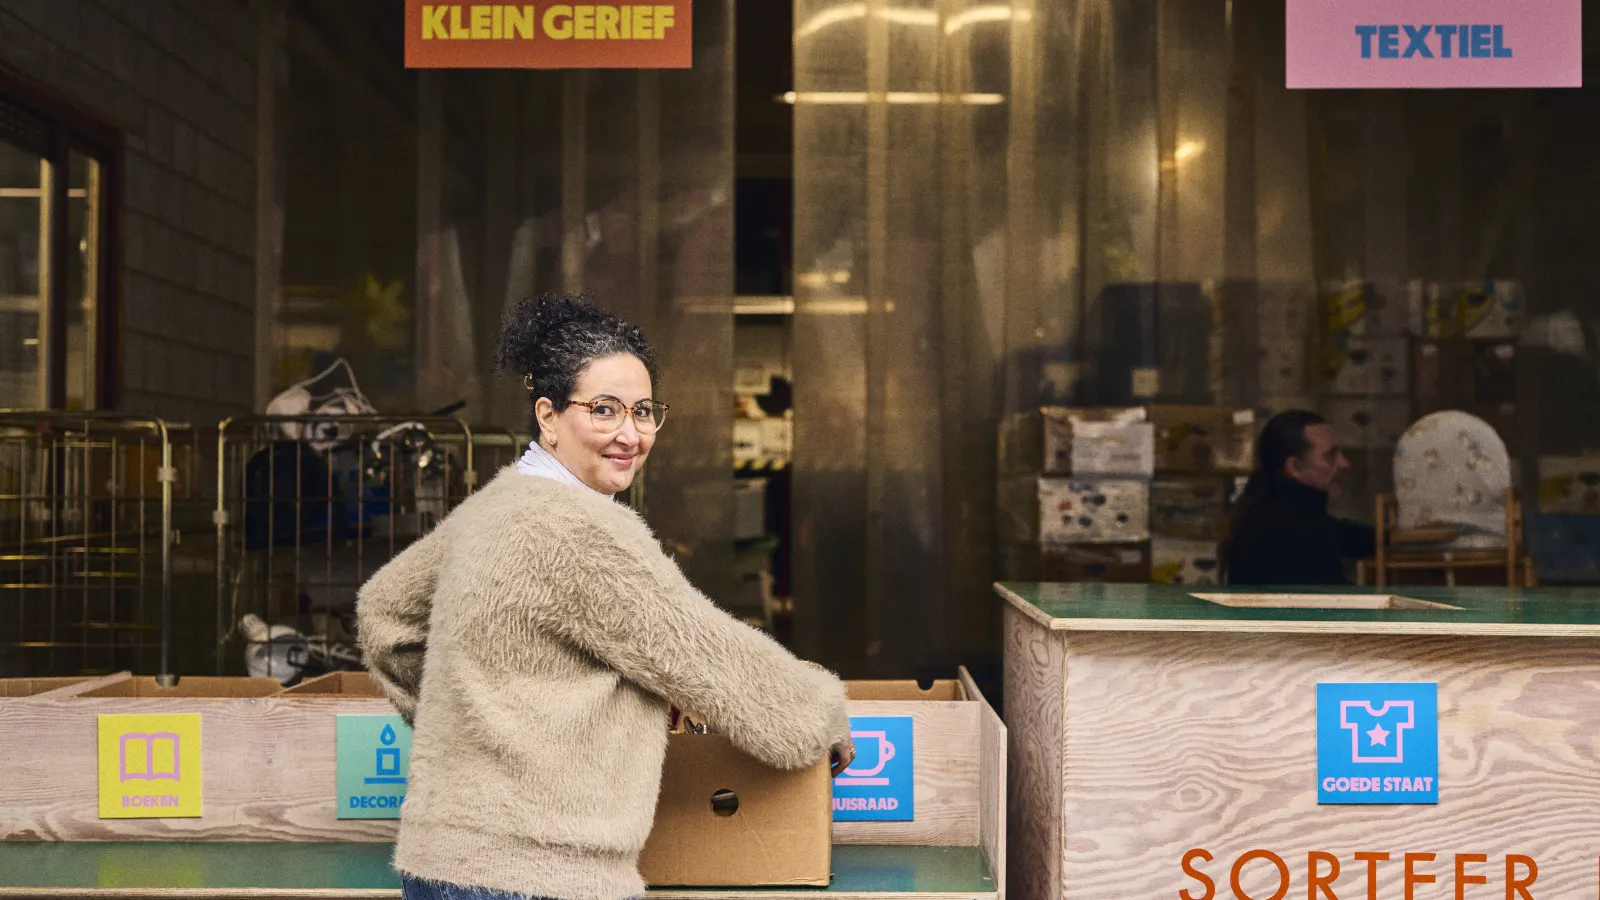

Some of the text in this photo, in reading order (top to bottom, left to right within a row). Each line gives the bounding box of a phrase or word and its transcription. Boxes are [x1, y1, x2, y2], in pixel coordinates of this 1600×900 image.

[421, 5, 675, 40] KLEIN GERIEF
[1355, 24, 1513, 59] TEXTIEL
[1322, 777, 1433, 792] GOEDE STAAT
[121, 795, 179, 808] BOEKEN
